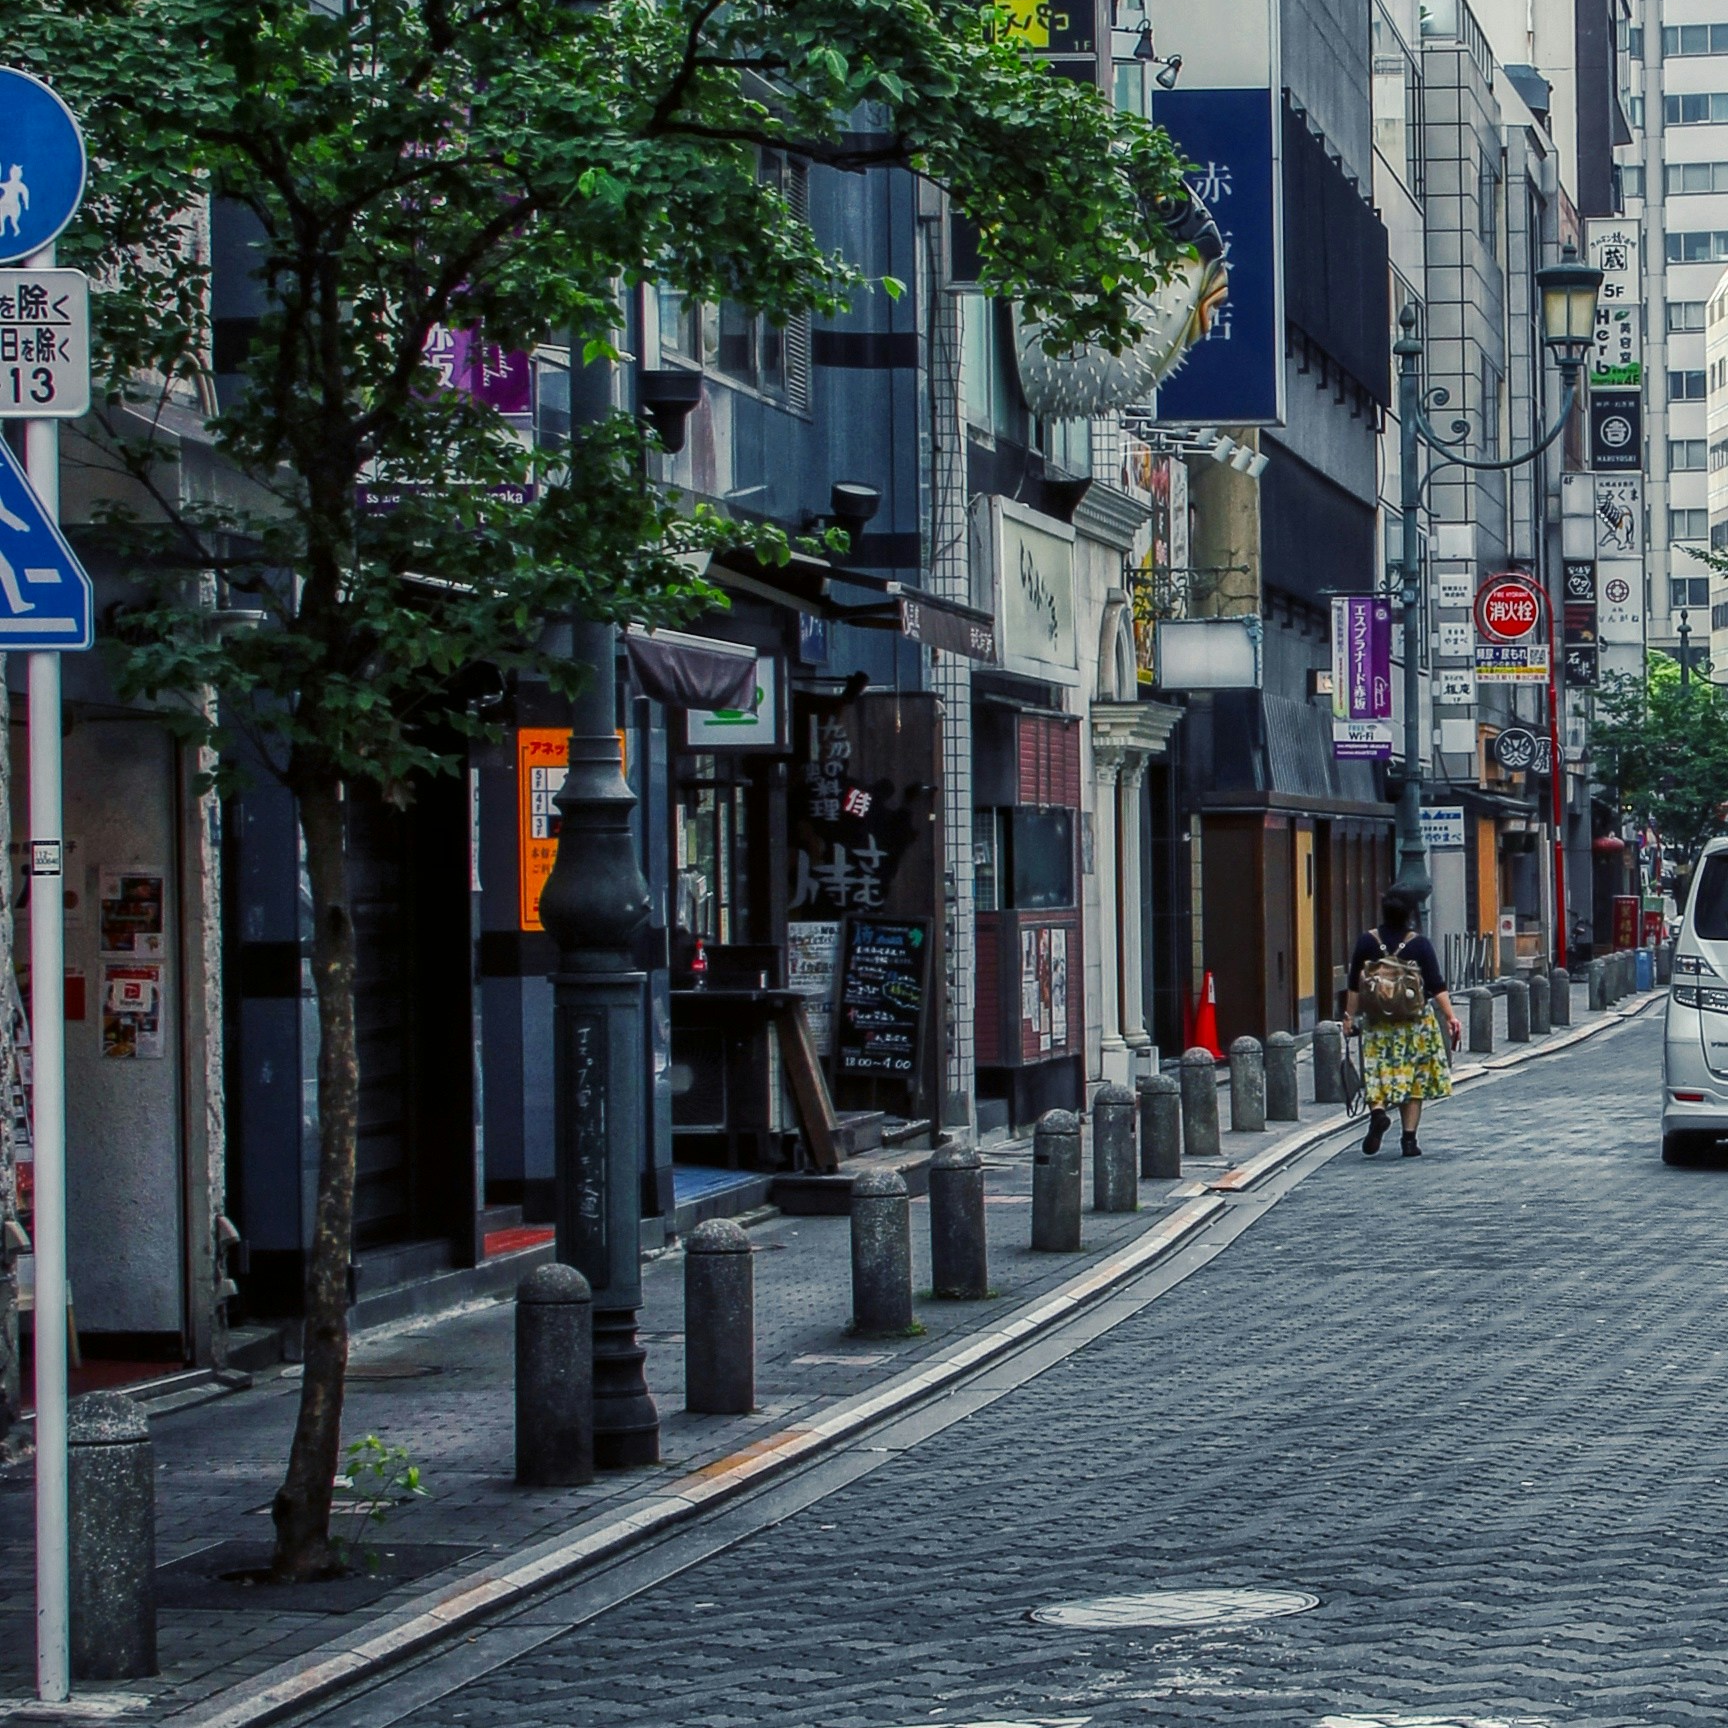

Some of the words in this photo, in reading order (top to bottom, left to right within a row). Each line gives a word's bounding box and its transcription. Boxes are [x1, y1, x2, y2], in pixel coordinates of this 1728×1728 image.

[1603, 283, 1625, 299] 5F
[1489, 600, 1534, 622] 消火栓
[1353, 604, 1367, 711] エスプラナード赤坂
[1348, 731, 1374, 741] Wi-Fi
